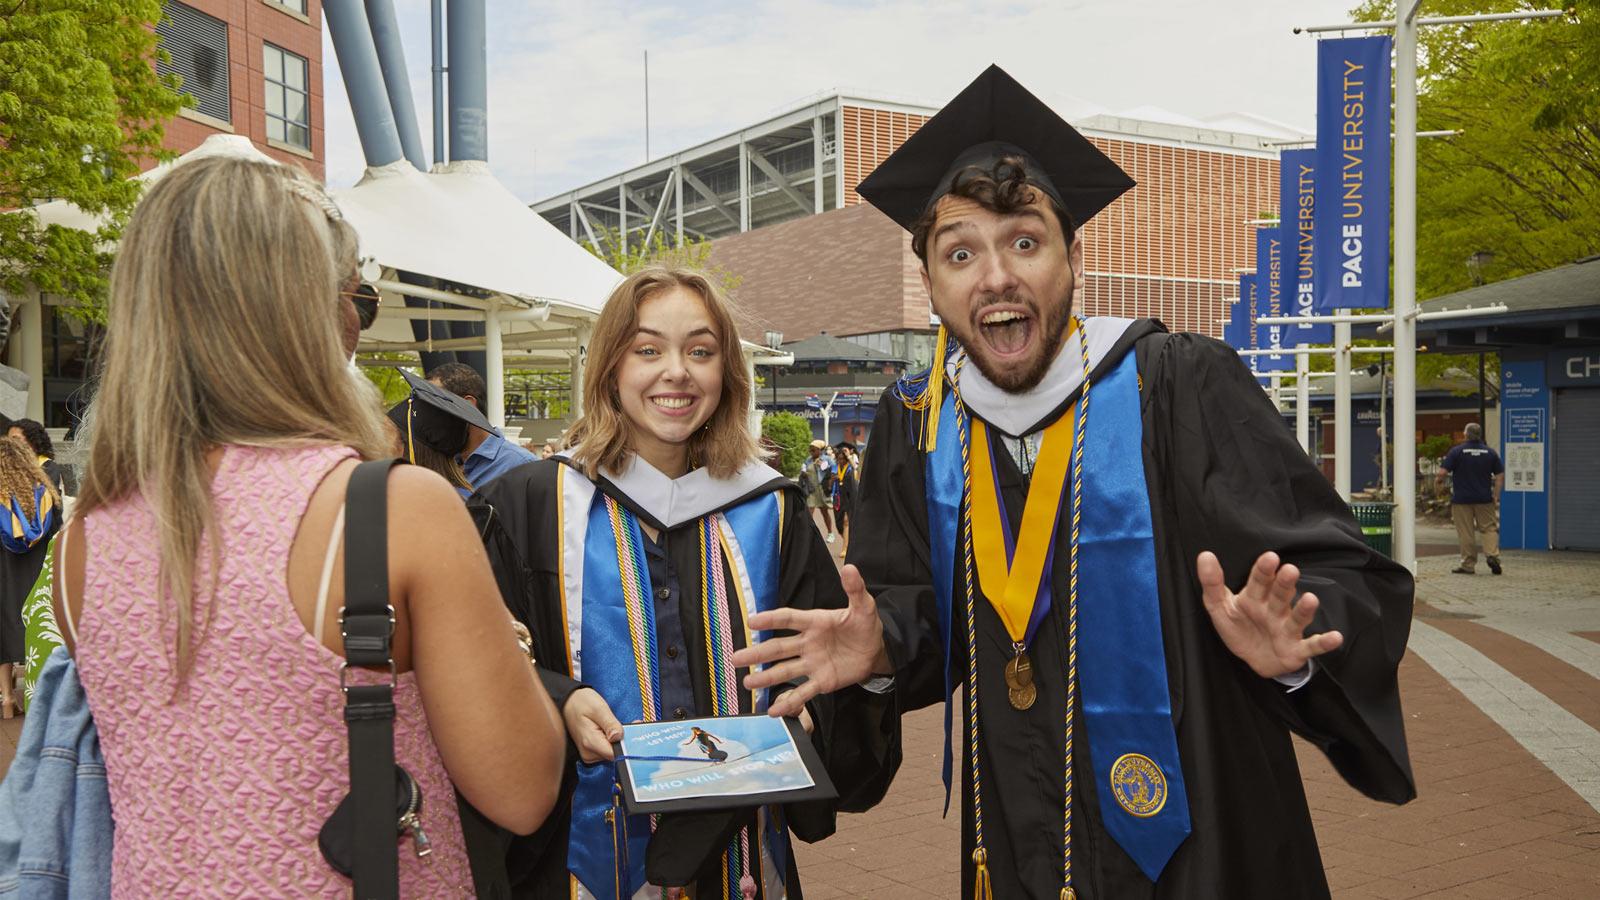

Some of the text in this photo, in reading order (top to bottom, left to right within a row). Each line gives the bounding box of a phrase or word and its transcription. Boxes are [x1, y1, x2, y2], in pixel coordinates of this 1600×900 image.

[1298, 165, 1315, 279] UNIVERSITY
[1342, 60, 1364, 287] PACE UNIVERSITY
[642, 780, 684, 792] WHO
[686, 772, 725, 785] WILL
